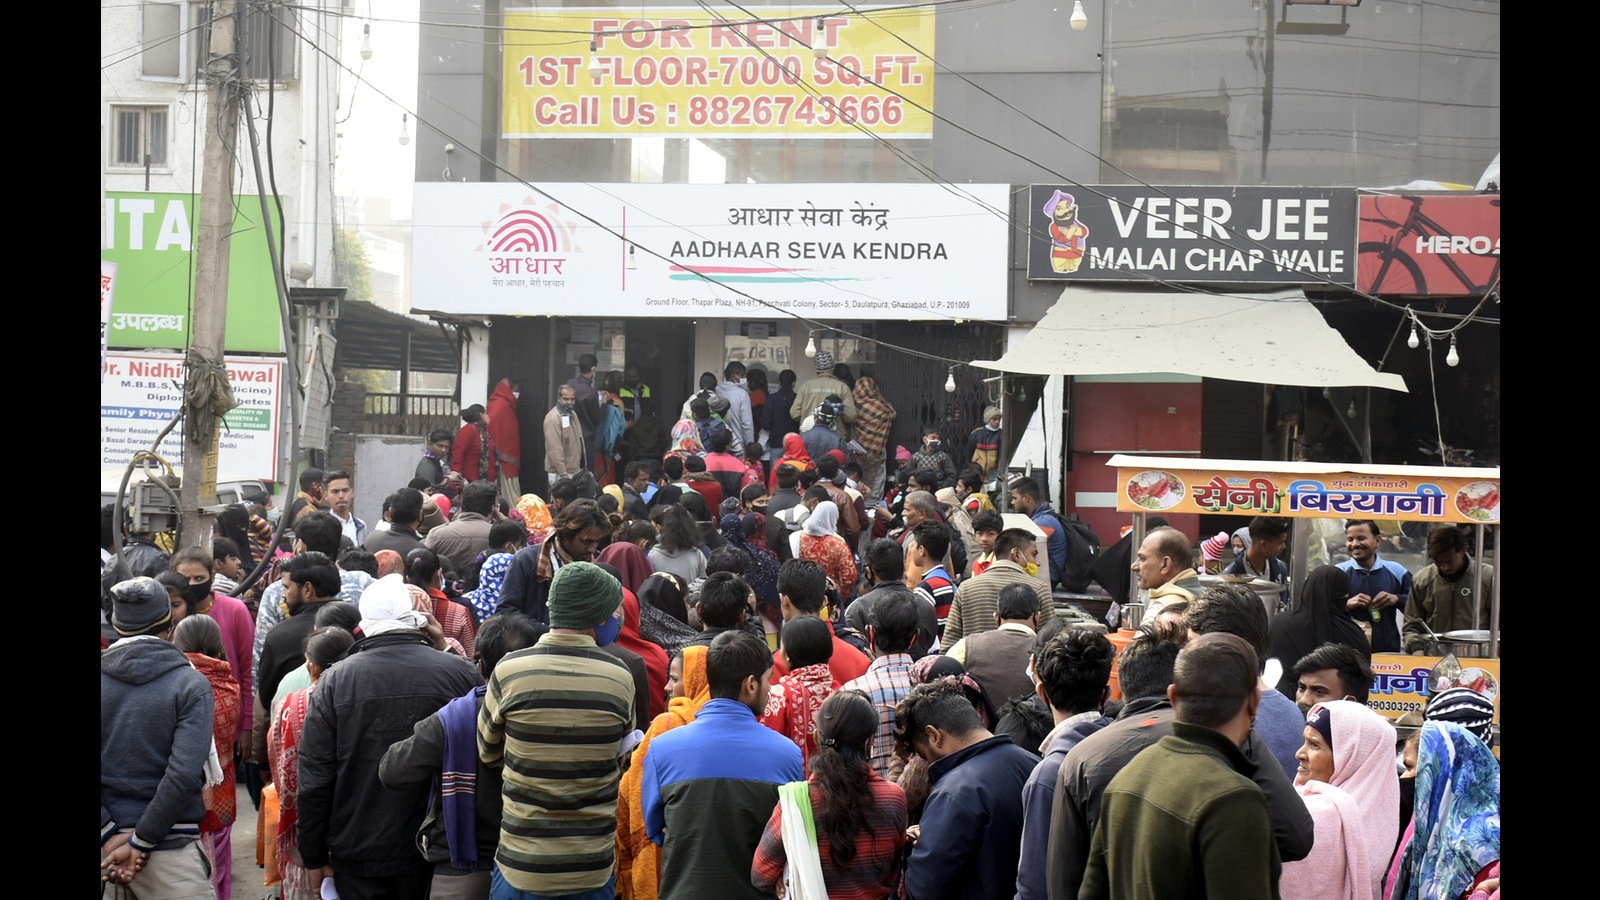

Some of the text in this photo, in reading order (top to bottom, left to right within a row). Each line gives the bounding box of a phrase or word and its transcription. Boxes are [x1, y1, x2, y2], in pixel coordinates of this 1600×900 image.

[592, 18, 849, 48] FOR RENT
[519, 56, 922, 88] 1ST FLOOR-7000 SQ.FT.
[535, 97, 598, 125] Call
[612, 97, 656, 125] Us
[689, 96, 902, 125] 8826743666
[728, 201, 890, 231] आधार सेवा केंद्र
[1108, 197, 1329, 241] VEER JEE
[670, 240, 948, 260] AADHAAR SEVA KENDRA
[489, 257, 566, 274] आधार
[1090, 246, 1344, 273] MALAI CHAP WALE
[492, 277, 503, 287] मेरा
[530, 277, 541, 287] मेरी
[646, 297, 670, 306] Ground
[691, 298, 713, 308] Thapar
[947, 301, 970, 309] 201009
[112, 313, 184, 331] उपलब्ध
[129, 361, 181, 378] Nidhi
[228, 368, 273, 382] awal
[232, 386, 272, 395] dicine)
[237, 397, 271, 405] betes
[101, 408, 135, 418] amily
[104, 446, 139, 454] Consultan
[1357, 480, 1409, 489] शाकाहारी
[1192, 476, 1447, 515] सैनी बिरयानी
[1367, 700, 1421, 712] 990303292
